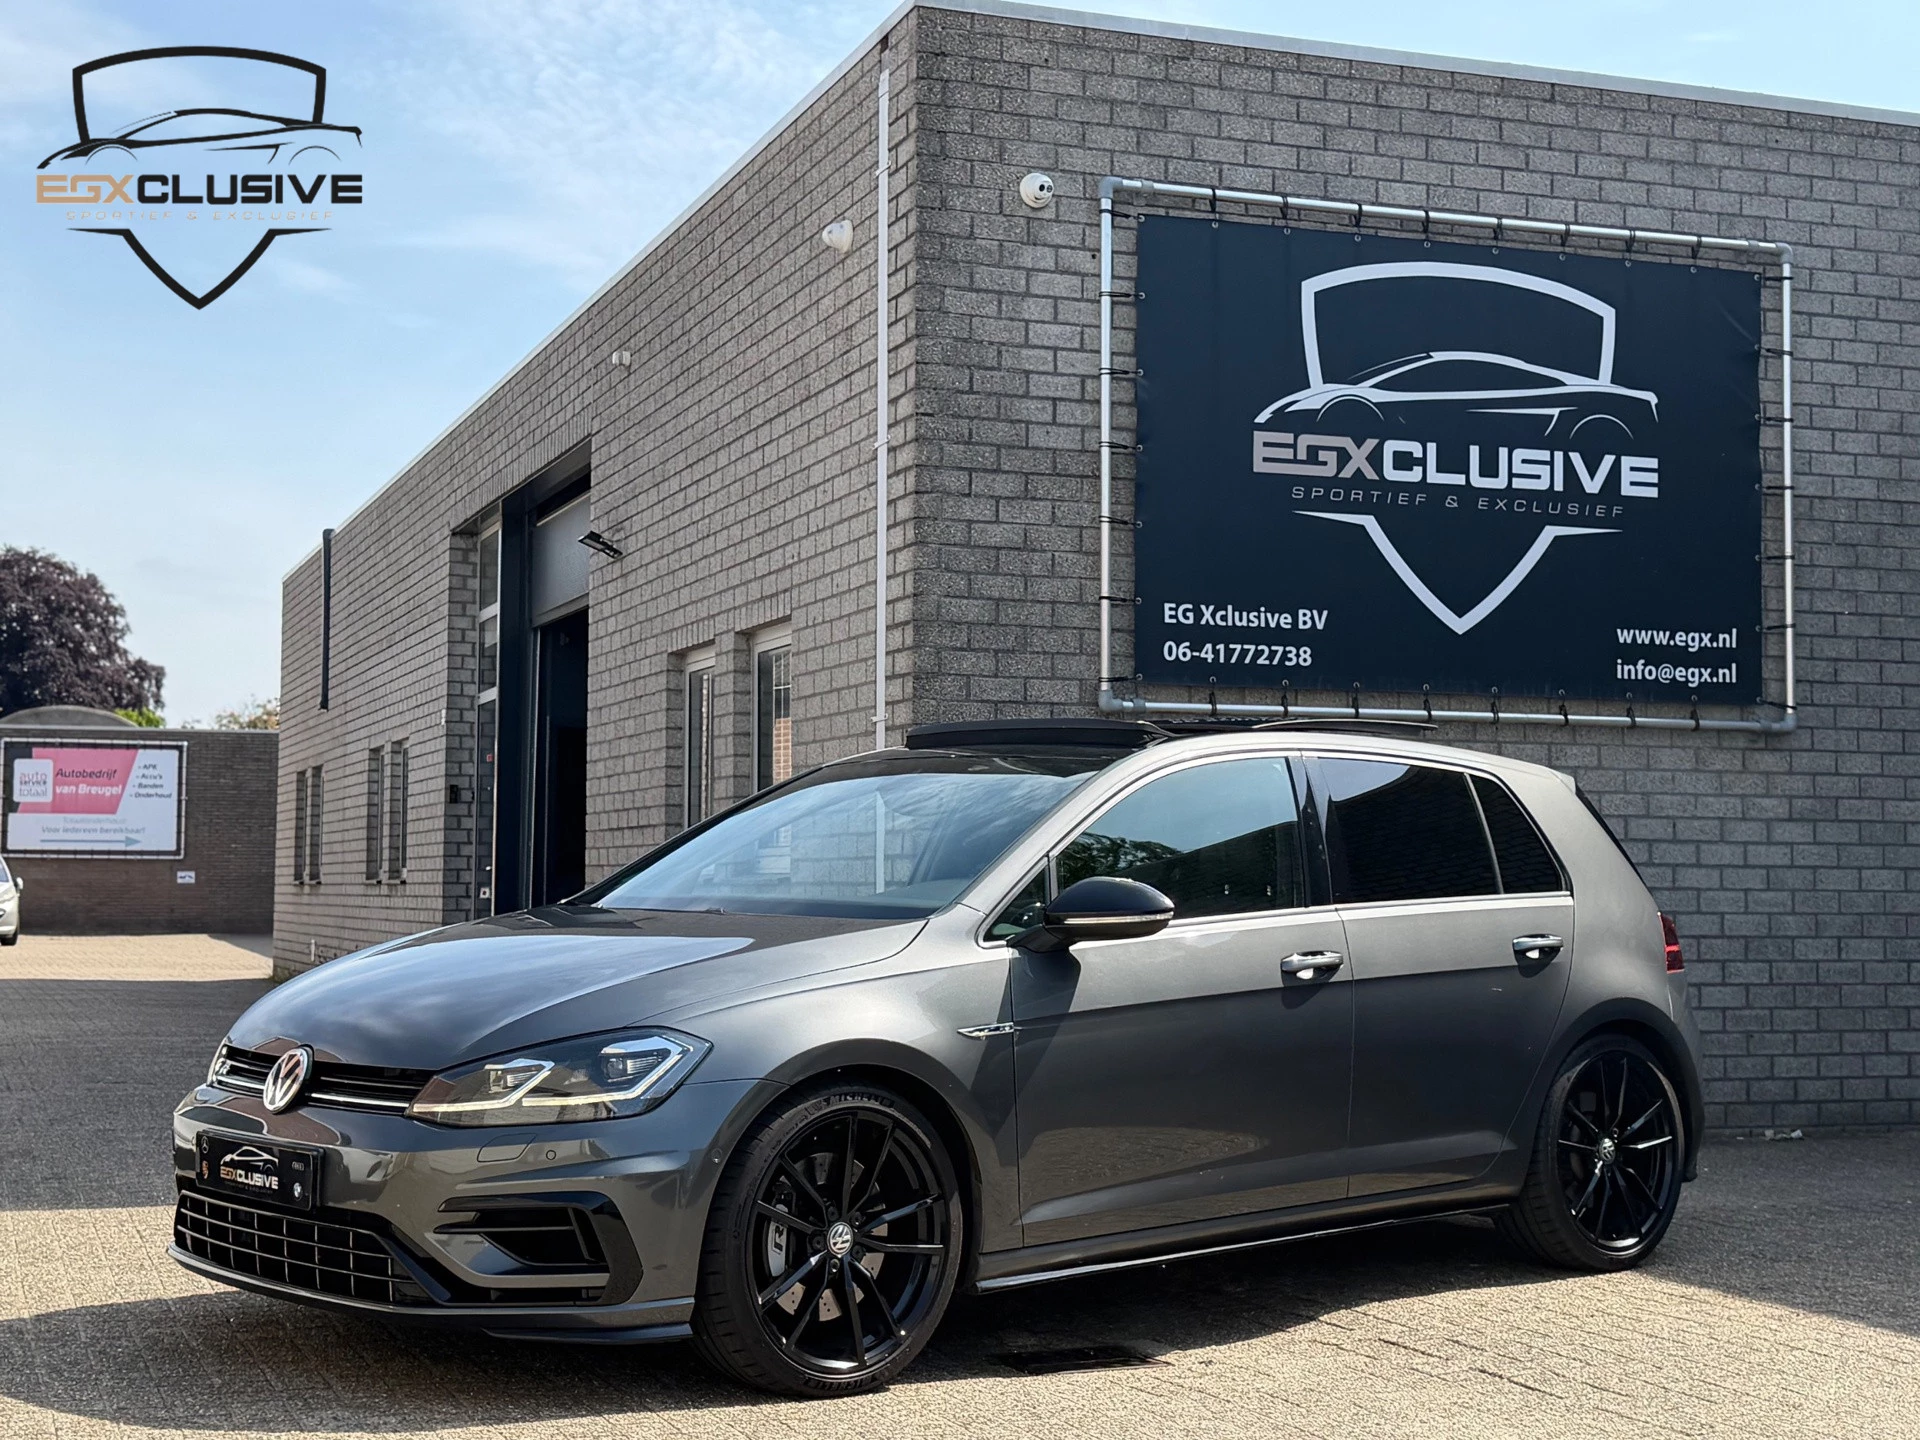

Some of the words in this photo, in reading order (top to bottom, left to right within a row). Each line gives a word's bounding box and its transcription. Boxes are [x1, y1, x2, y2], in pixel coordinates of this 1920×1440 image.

[1252, 430, 1659, 498] EGXCLUSIVE
[1291, 486, 1427, 507] SPORTIEF
[1445, 495, 1459, 508] &
[1478, 497, 1624, 518] EXCLUSIEF
[1163, 602, 1195, 625] EG
[1200, 604, 1293, 629] Xclusive
[1298, 609, 1329, 630] BV
[1162, 640, 1312, 667] 06-41772738
[1616, 628, 1737, 652] www.egx.nl
[1616, 659, 1737, 687] info@egx.nl
[55, 768, 118, 781] Autobedrijf
[55, 785, 76, 794] van
[78, 784, 122, 796] Breugel
